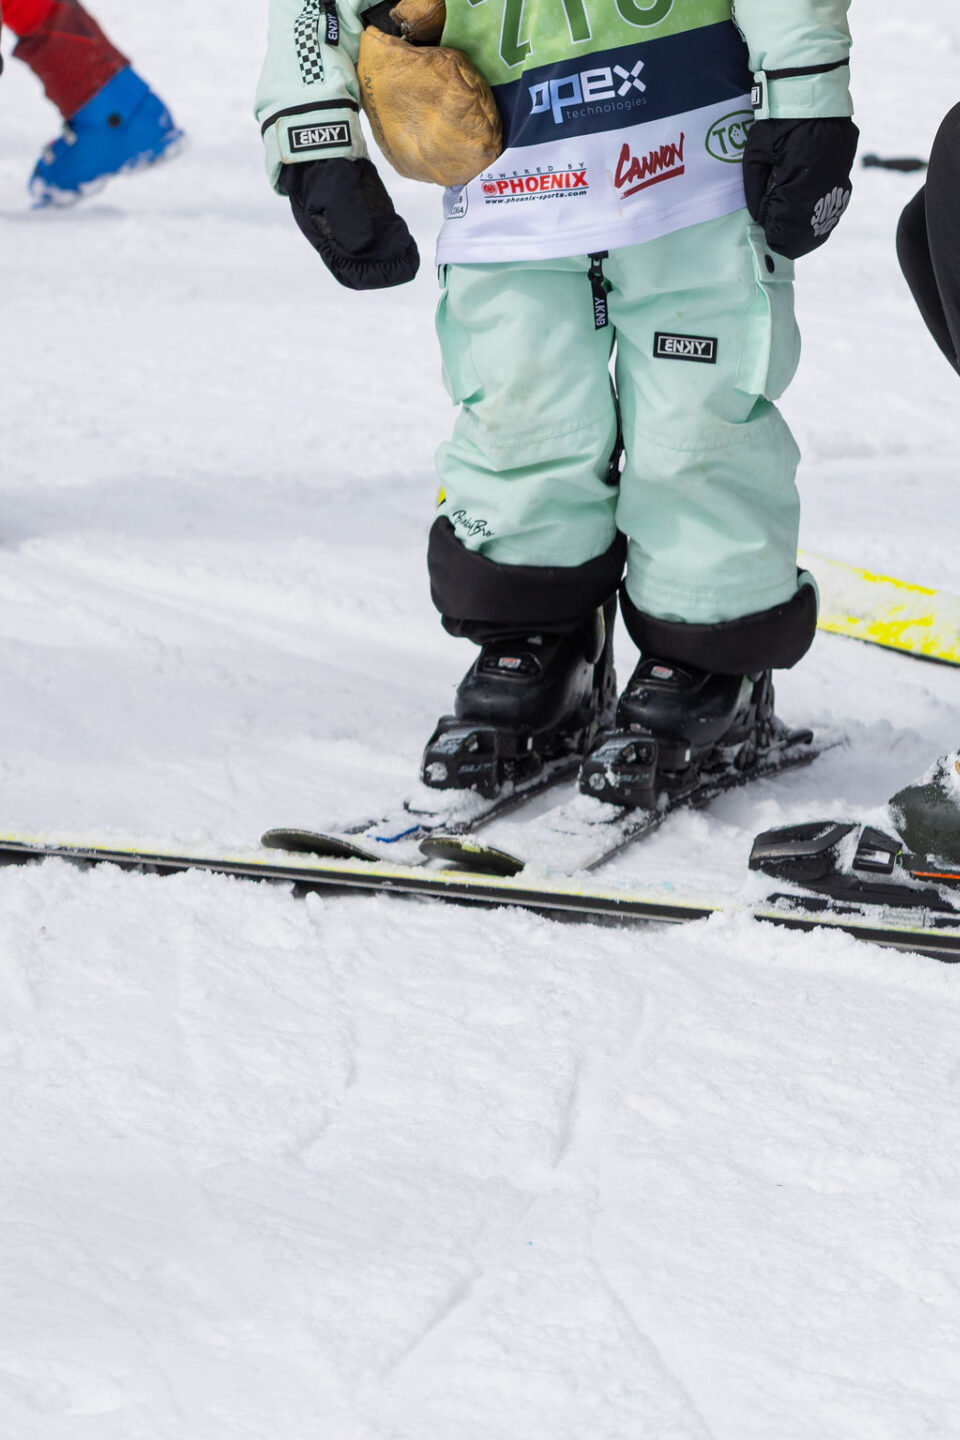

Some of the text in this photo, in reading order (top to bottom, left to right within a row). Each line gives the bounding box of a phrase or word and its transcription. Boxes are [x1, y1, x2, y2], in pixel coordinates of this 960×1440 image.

[566, 96, 648, 120] technologies
[567, 161, 585, 170] BY
[614, 132, 685, 189] CANNON
[496, 170, 589, 195] PHOENIX
[485, 190, 588, 205] www.phoenix-sports.com
